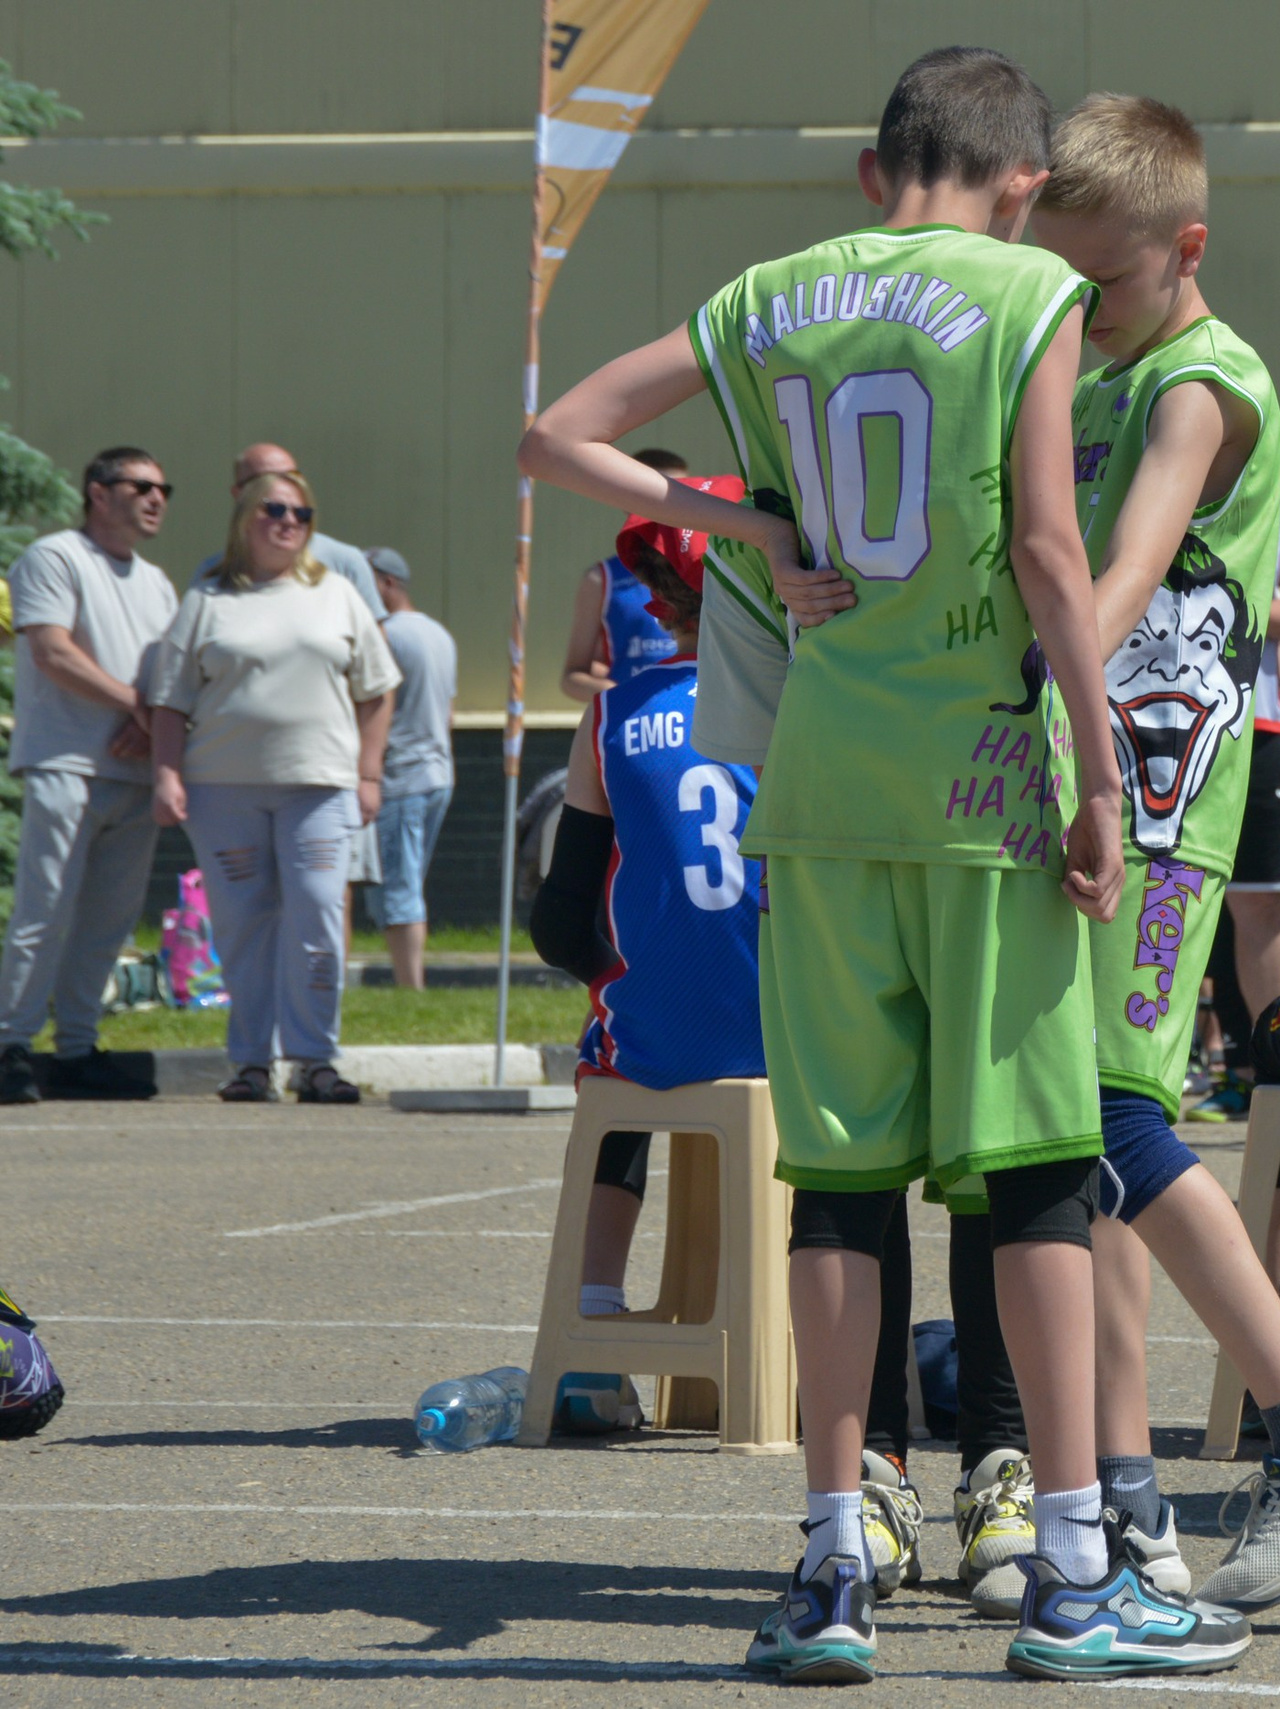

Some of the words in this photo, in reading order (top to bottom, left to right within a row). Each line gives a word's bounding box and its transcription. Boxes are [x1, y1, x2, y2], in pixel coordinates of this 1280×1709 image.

[745, 271, 990, 369] MALOUSHKIN
[773, 367, 933, 581] 10
[946, 595, 999, 650] HA
[624, 711, 685, 757] EMG
[971, 724, 1032, 773] HA
[945, 775, 1005, 820] HA
[678, 764, 746, 912] 3
[996, 821, 1052, 867] HA
